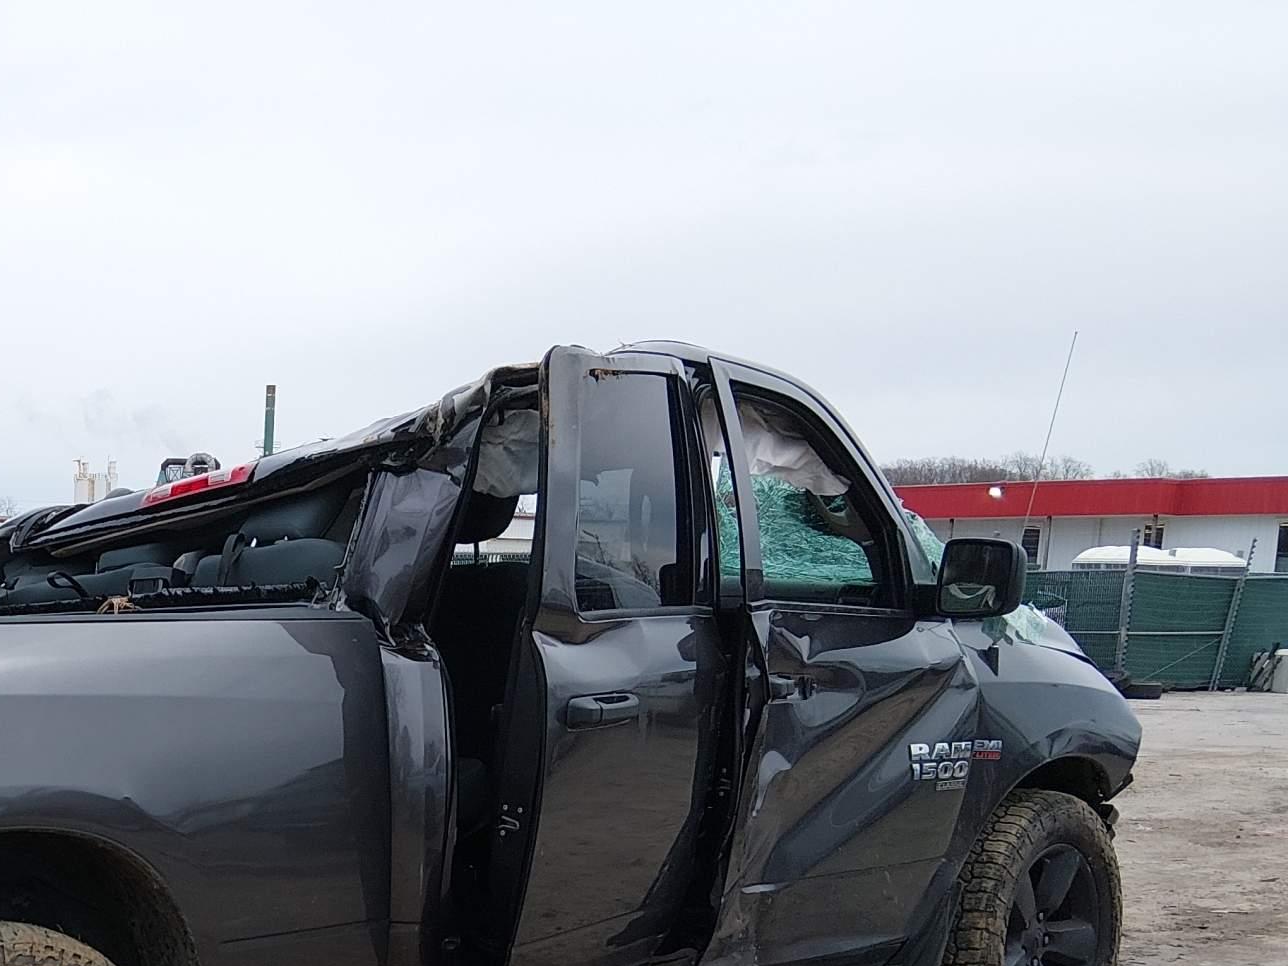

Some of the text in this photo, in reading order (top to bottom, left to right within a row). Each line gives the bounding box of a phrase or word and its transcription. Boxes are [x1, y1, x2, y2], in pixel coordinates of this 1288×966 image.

[910, 741, 972, 760] RAM
[974, 739, 1002, 750] EMI
[911, 760, 969, 781] 1500
